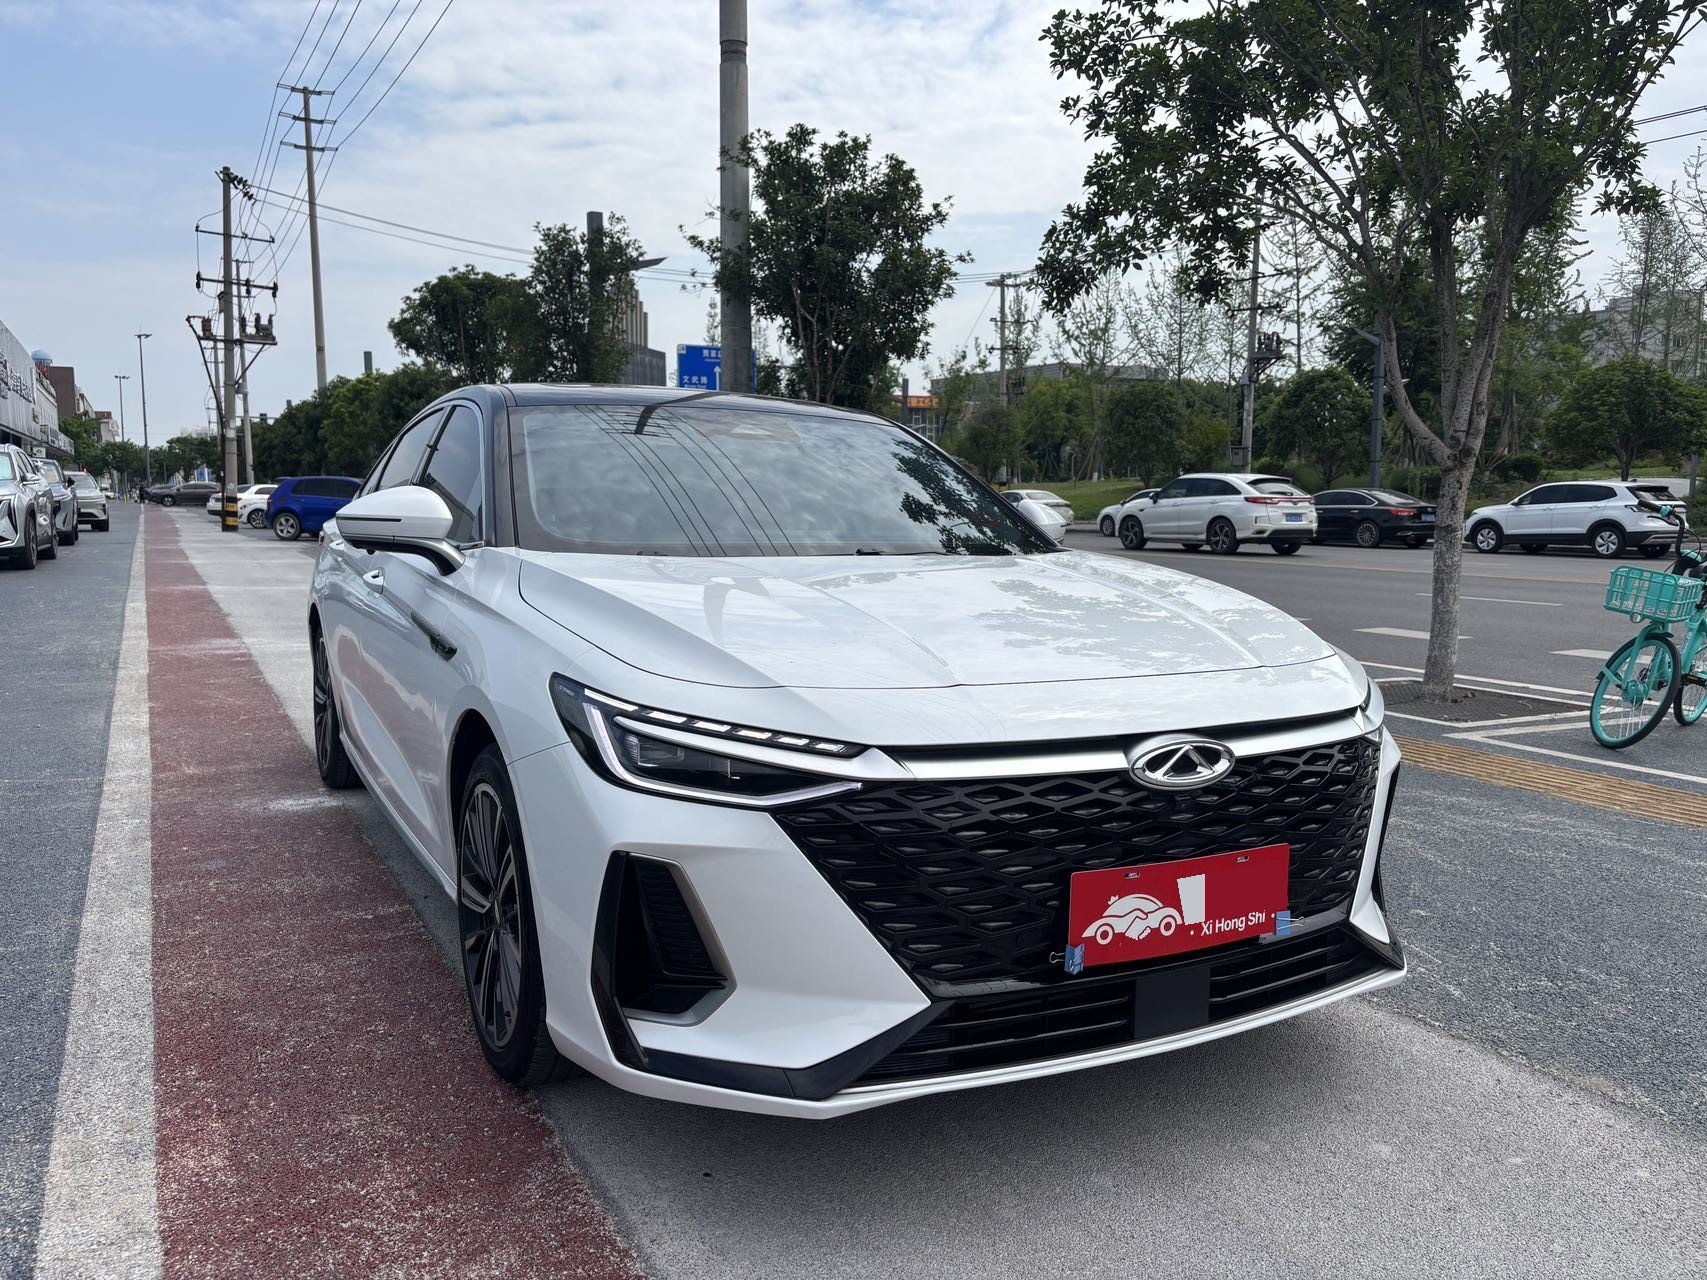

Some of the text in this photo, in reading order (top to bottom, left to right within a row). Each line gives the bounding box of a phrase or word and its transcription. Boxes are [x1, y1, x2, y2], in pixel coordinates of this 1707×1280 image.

[1201, 910, 1266, 936] Xi Hong Shi
